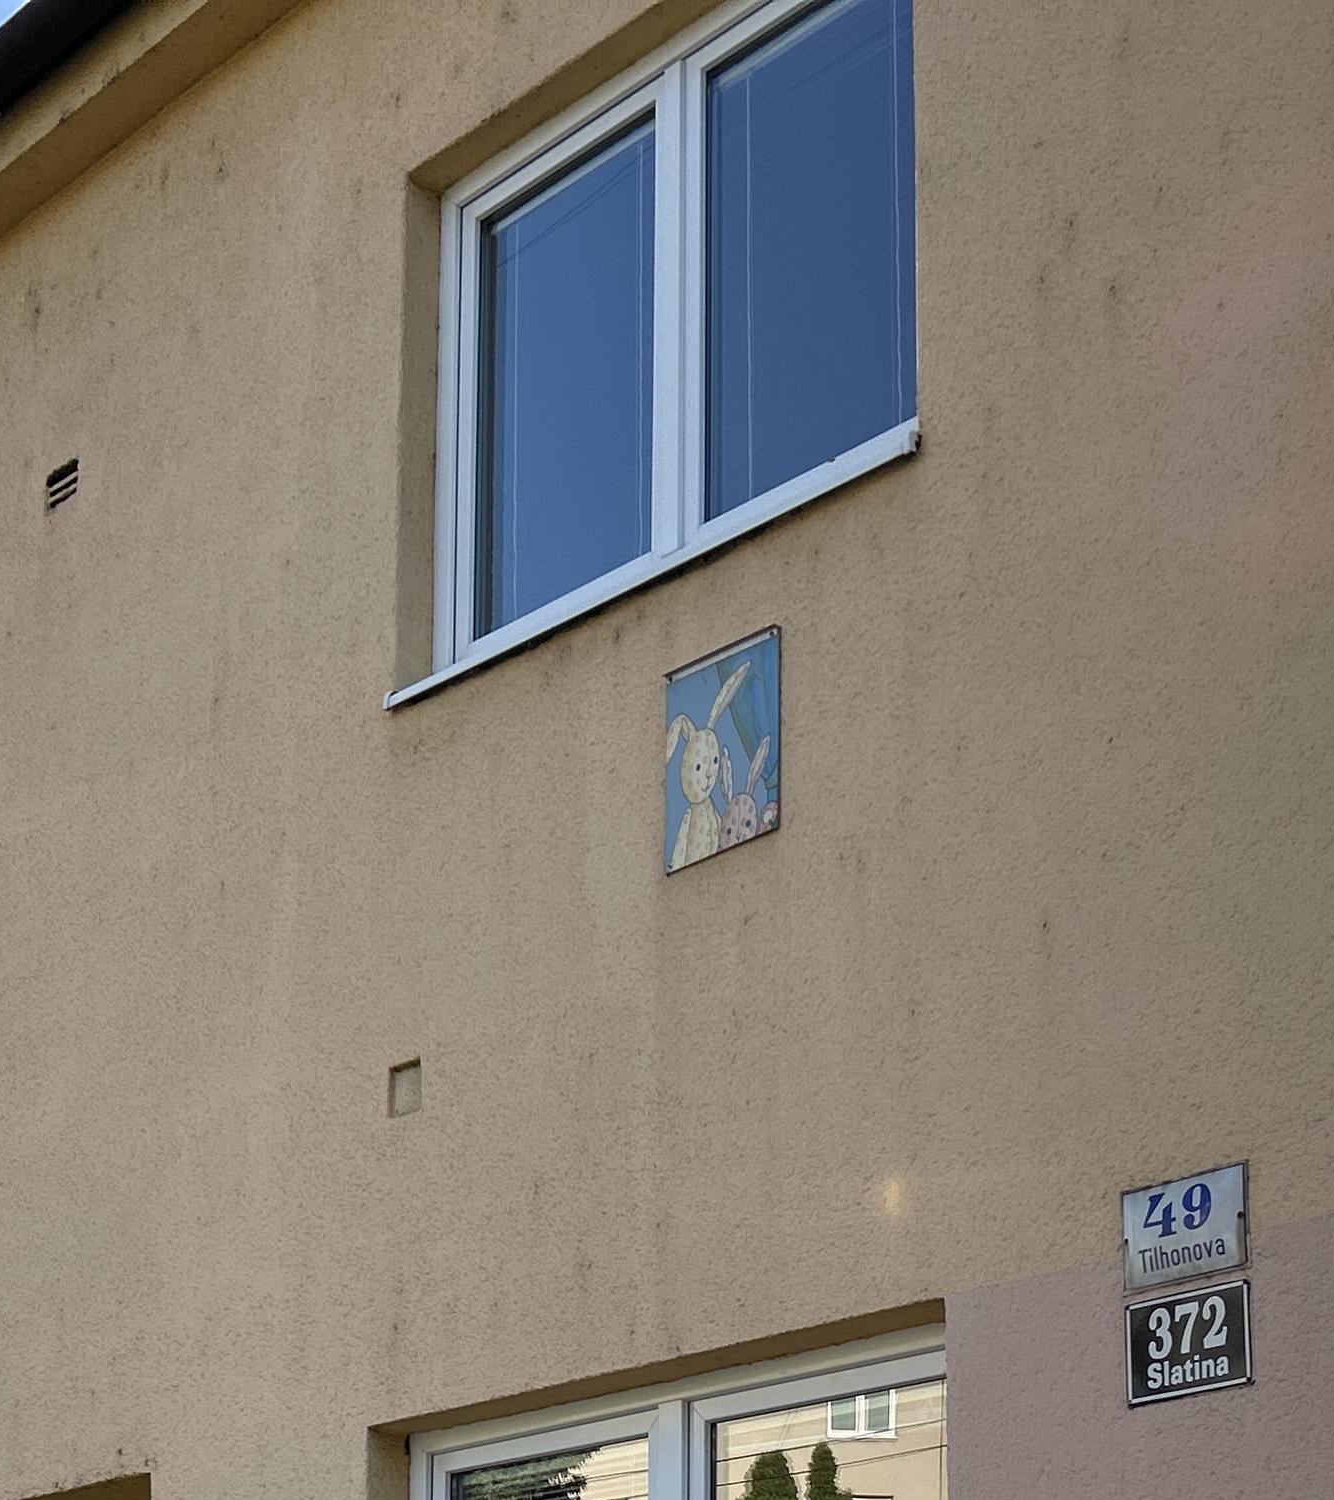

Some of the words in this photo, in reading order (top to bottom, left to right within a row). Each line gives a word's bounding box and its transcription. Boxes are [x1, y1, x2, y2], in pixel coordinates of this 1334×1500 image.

[1142, 1183, 1213, 1238] 49
[1138, 1237, 1226, 1274] Tilhonova
[1147, 1295, 1228, 1360] 372
[1146, 1354, 1230, 1390] Slatina
